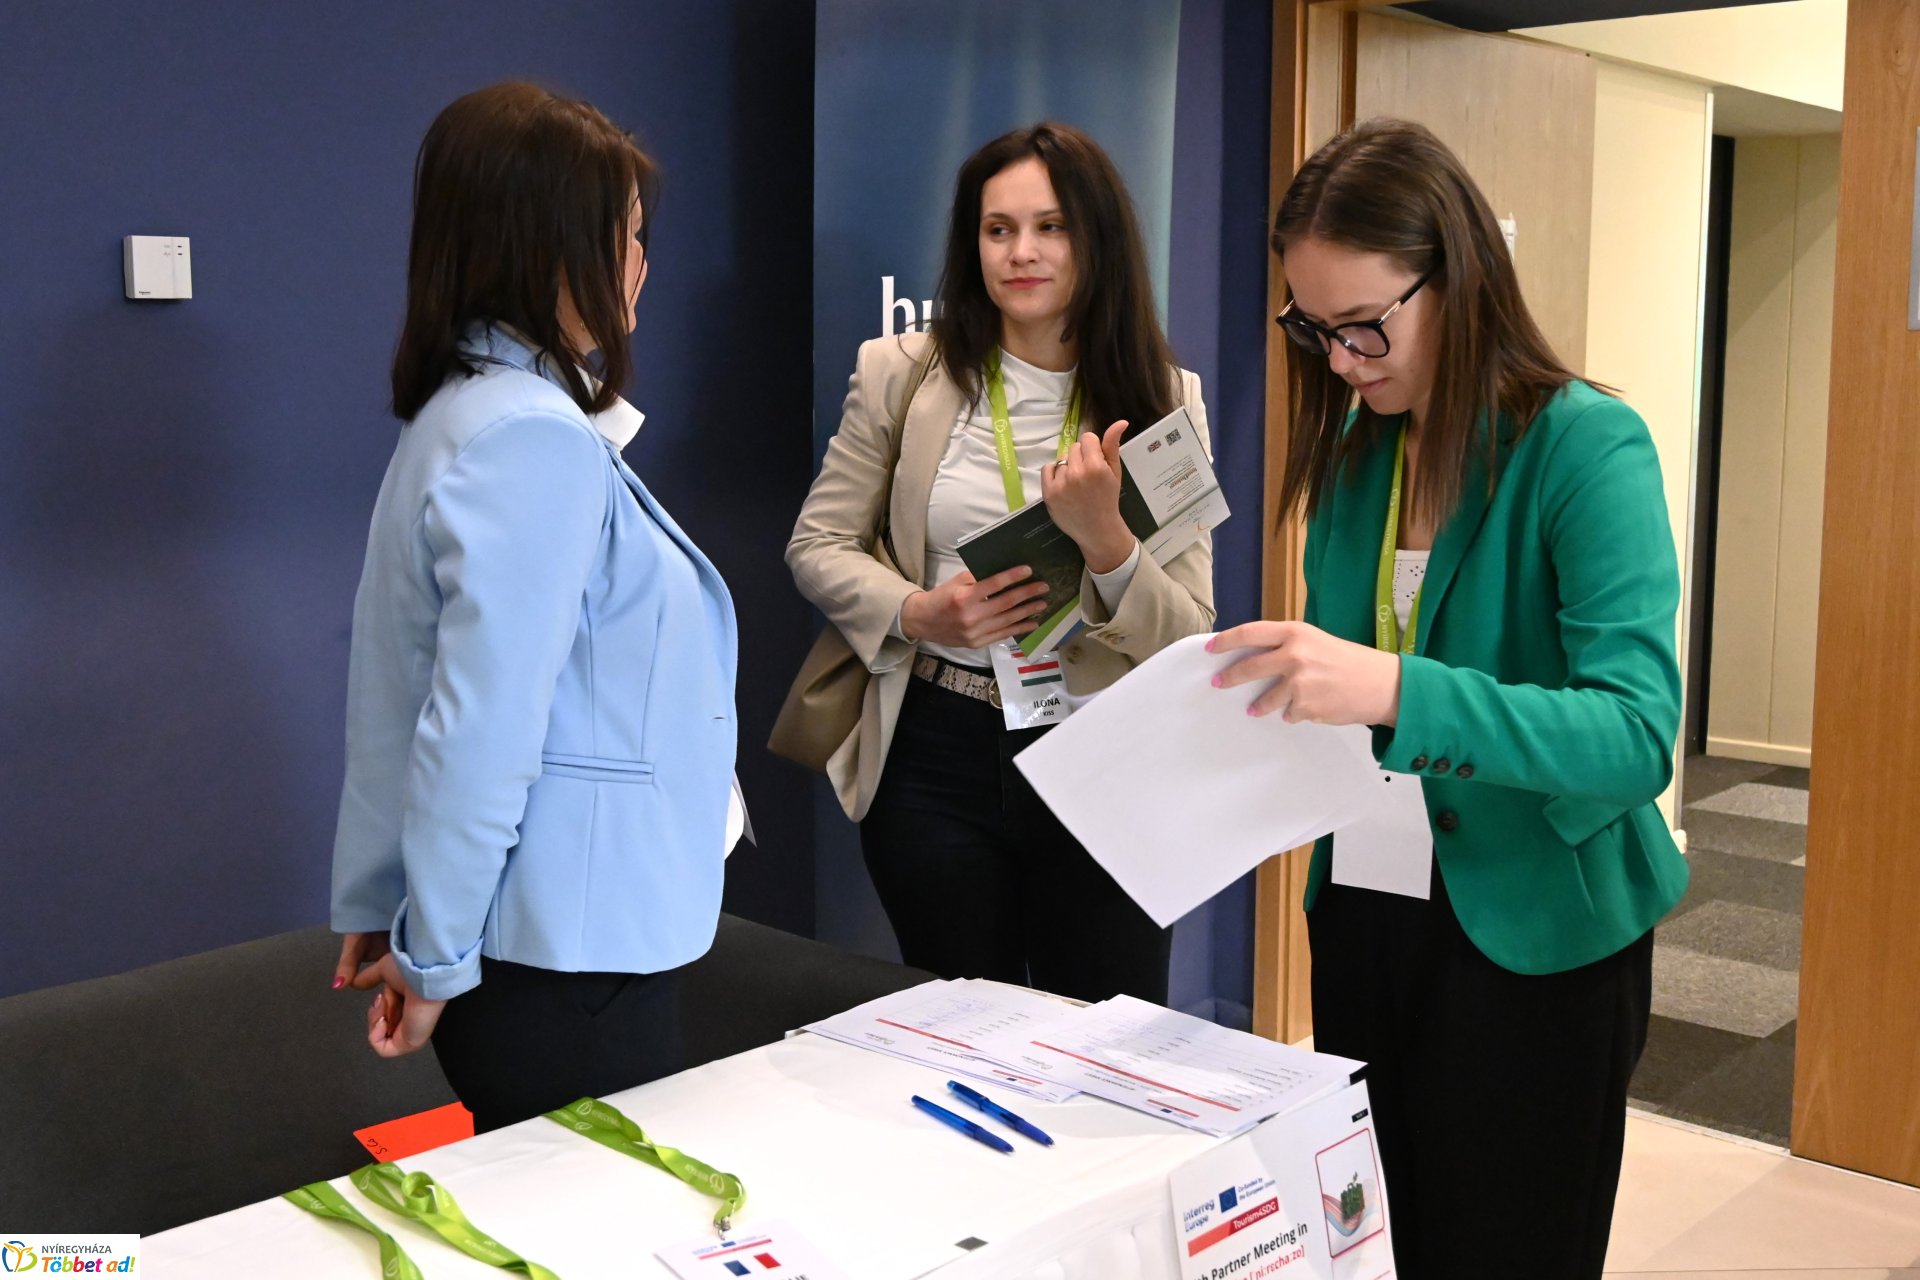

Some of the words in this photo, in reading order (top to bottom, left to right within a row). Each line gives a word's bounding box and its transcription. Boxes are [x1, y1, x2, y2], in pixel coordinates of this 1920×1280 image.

[1033, 697, 1061, 709] ILONA
[1183, 1199, 1215, 1222] Interreg
[1233, 1201, 1277, 1229] Tourism4SDG
[1184, 1215, 1209, 1232] Europe
[1211, 1252, 1252, 1280] Partner
[1253, 1231, 1297, 1260] Meeting
[1297, 1222, 1309, 1237] in
